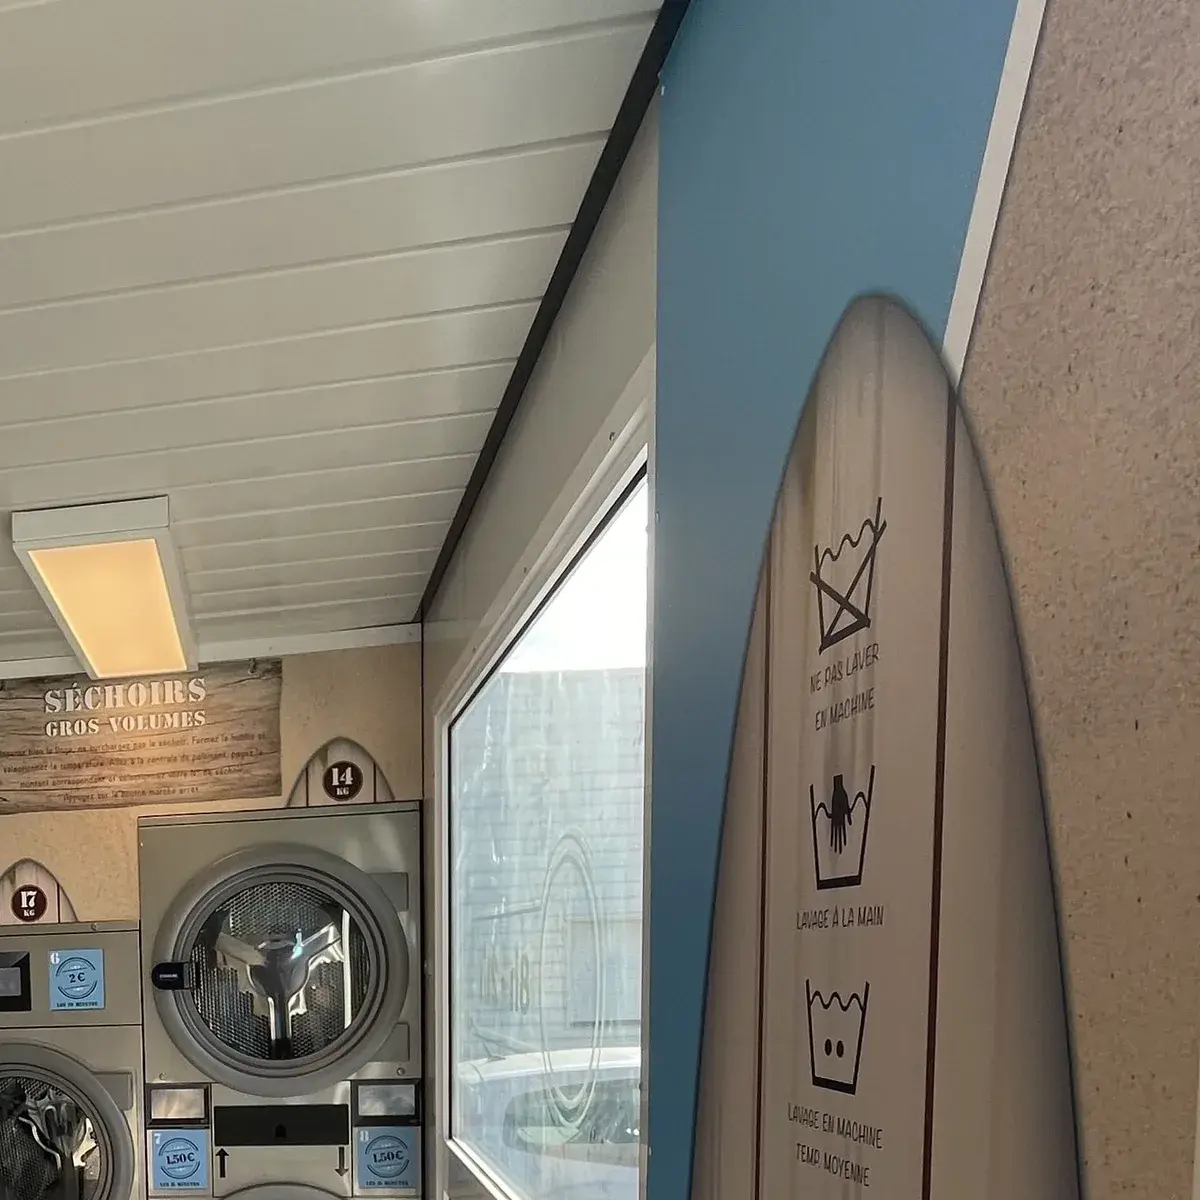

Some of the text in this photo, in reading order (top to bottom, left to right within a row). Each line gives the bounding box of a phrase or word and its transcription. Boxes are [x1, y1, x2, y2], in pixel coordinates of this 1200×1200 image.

[810, 642, 880, 693] NE PAS LAVER
[44, 677, 207, 713] SÉCHOIRS
[815, 687, 875, 731] EN MACHINE
[45, 710, 207, 738] GROS VOLUMES
[331, 767, 354, 786] 14
[336, 787, 349, 795] KG
[21, 891, 37, 908] 17
[24, 909, 35, 917] KG
[796, 909, 829, 930] LAVAGE
[842, 907, 854, 928] LA
[857, 905, 884, 926] MAIN
[50, 952, 60, 964] 6
[360, 1130, 369, 1142] 8
[788, 1102, 883, 1149] LAVAGE EN MACHINE
[154, 1133, 161, 1144] 7
[824, 1152, 870, 1187] MOYENNE
